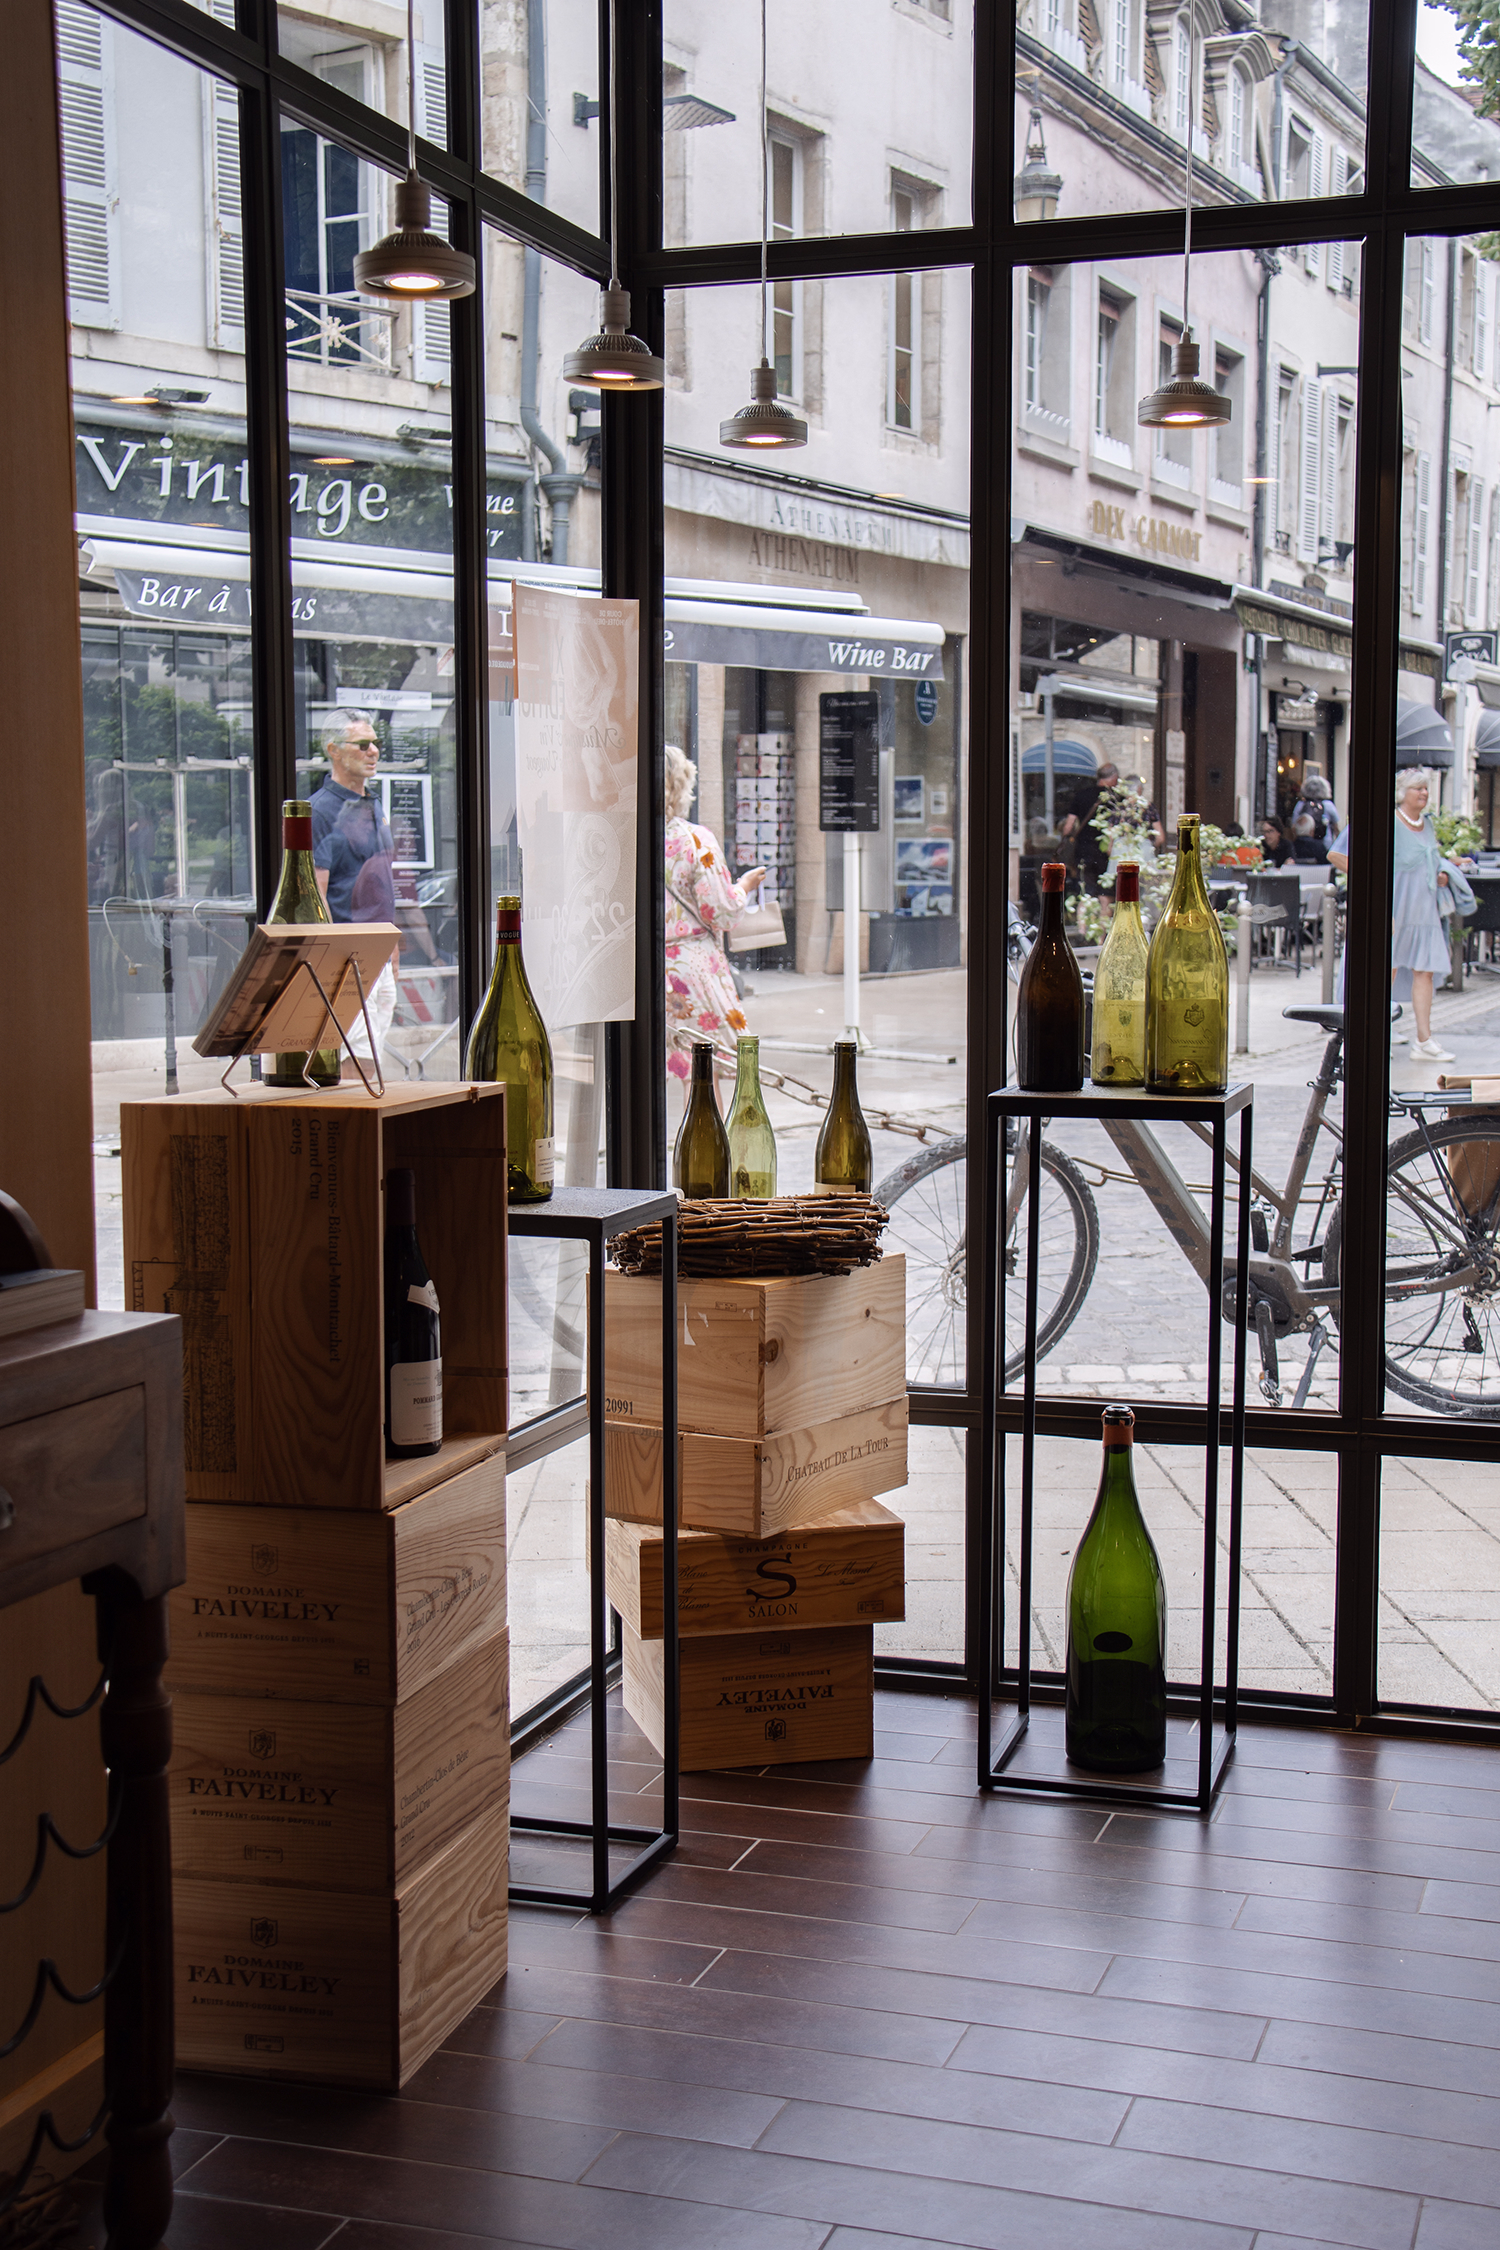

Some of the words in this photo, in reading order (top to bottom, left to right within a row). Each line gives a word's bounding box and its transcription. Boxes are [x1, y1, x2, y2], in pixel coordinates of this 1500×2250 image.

[1092, 500, 1125, 541] DIX
[1137, 515, 1203, 562] CARNOT
[137, 577, 202, 610] Bar
[208, 584, 231, 613] à
[828, 641, 886, 668] Wine
[890, 646, 934, 672] Bar
[290, 1117, 303, 1155] 2015
[309, 1118, 323, 1168] Grand
[309, 1171, 323, 1200] Cru
[327, 1120, 342, 1363] Bienvenues-Bâtard-Montrachet
[605, 1397, 634, 1416] 20991
[786, 1457, 831, 1482] CHATEAU
[865, 1437, 889, 1455] TOUR
[738, 1542, 808, 1554] CHAMPAGNE
[227, 1585, 305, 1598] DOMAINE
[746, 1552, 797, 1603] S
[192, 1597, 341, 1621] FAIVELEY
[748, 1602, 799, 1618] SALON
[716, 1684, 835, 1707] FAIVELEY
[744, 1701, 807, 1714] DOMAINE
[223, 1767, 303, 1782] DOMAINE
[187, 1777, 339, 1807] FAIVELEY
[401, 1803, 419, 1829] Grand
[224, 1954, 305, 1971] DOMAINE
[187, 1964, 341, 1996] FAIVELEY
